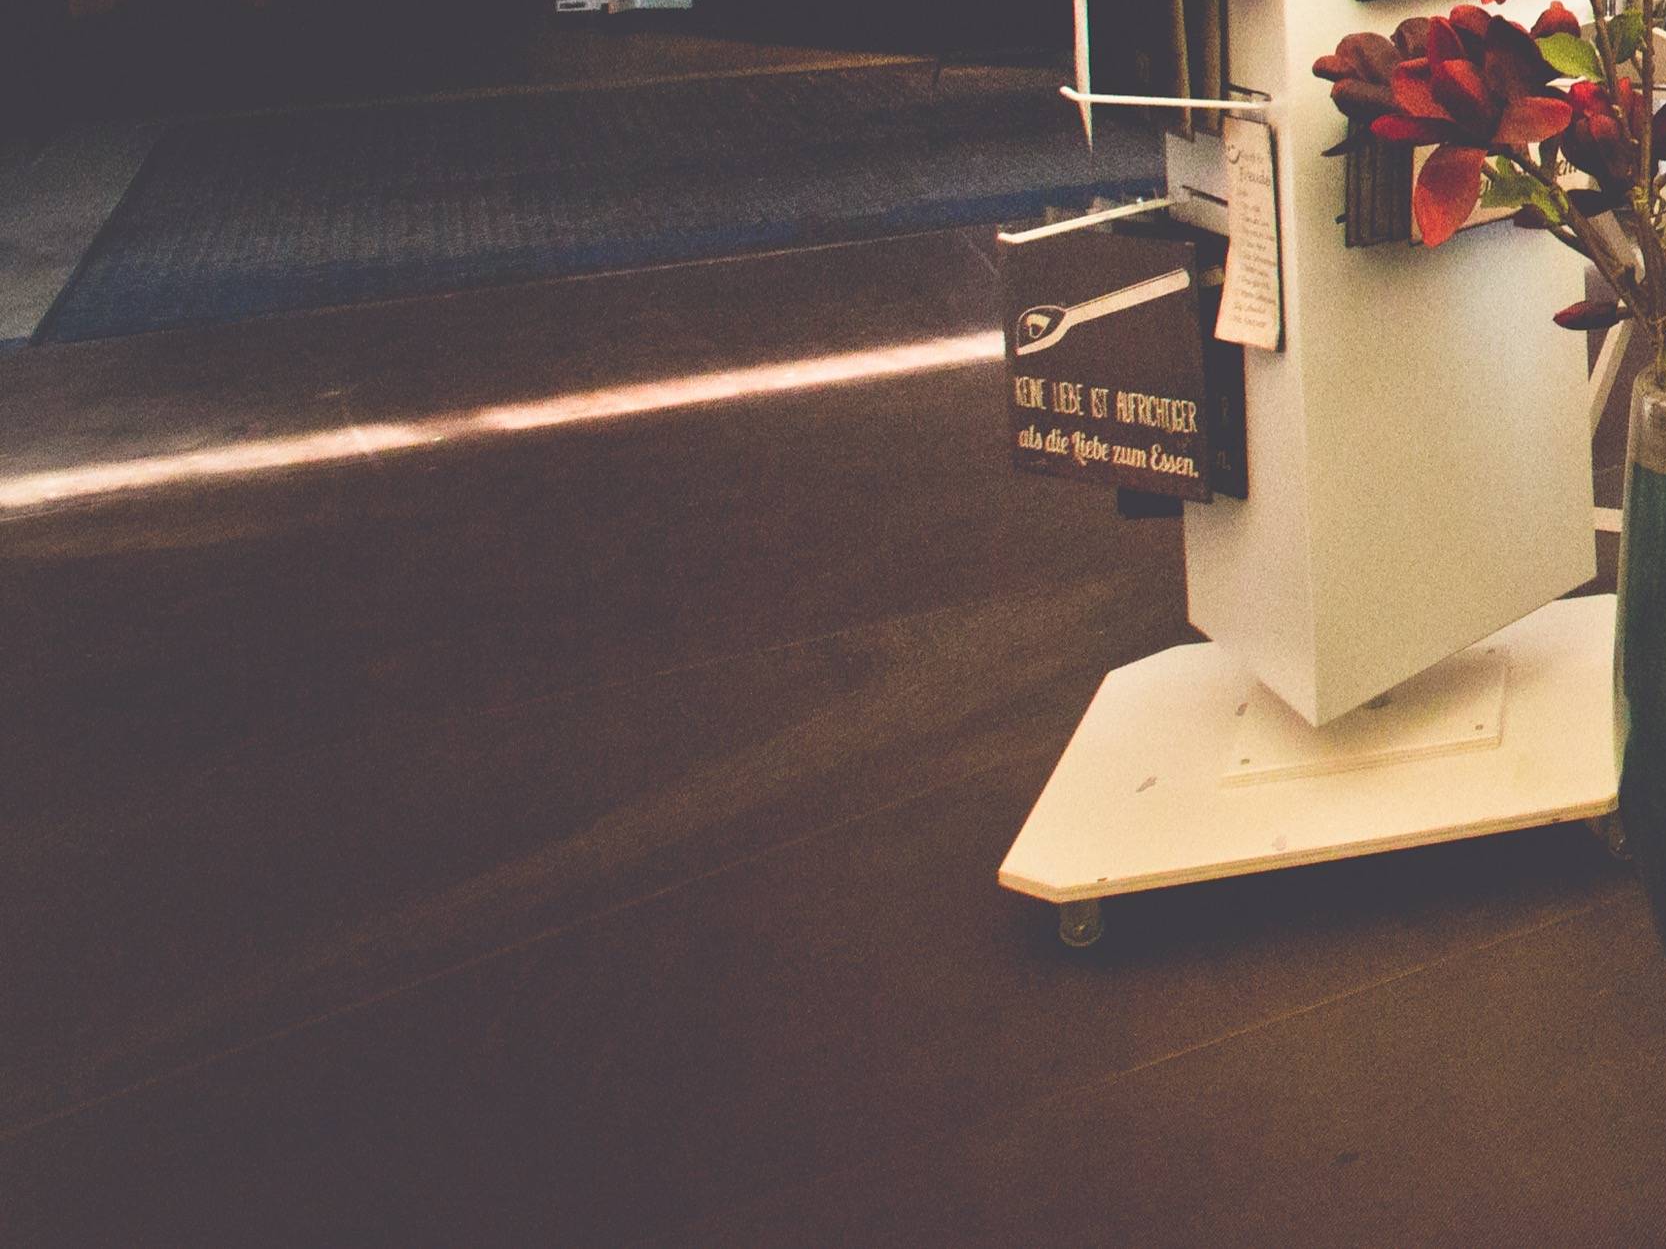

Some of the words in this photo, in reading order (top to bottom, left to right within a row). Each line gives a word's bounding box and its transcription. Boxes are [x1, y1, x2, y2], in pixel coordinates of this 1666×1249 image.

[1015, 376, 1047, 410] KEINE
[1053, 381, 1085, 416] LIEBE
[1090, 387, 1110, 419] IST
[1116, 390, 1198, 434] AUFRICHTIGER
[1018, 424, 1043, 450] als
[1044, 428, 1068, 455] die
[1072, 429, 1111, 467] Liebe
[1113, 445, 1147, 469] zum
[1150, 443, 1199, 478] Essen.
